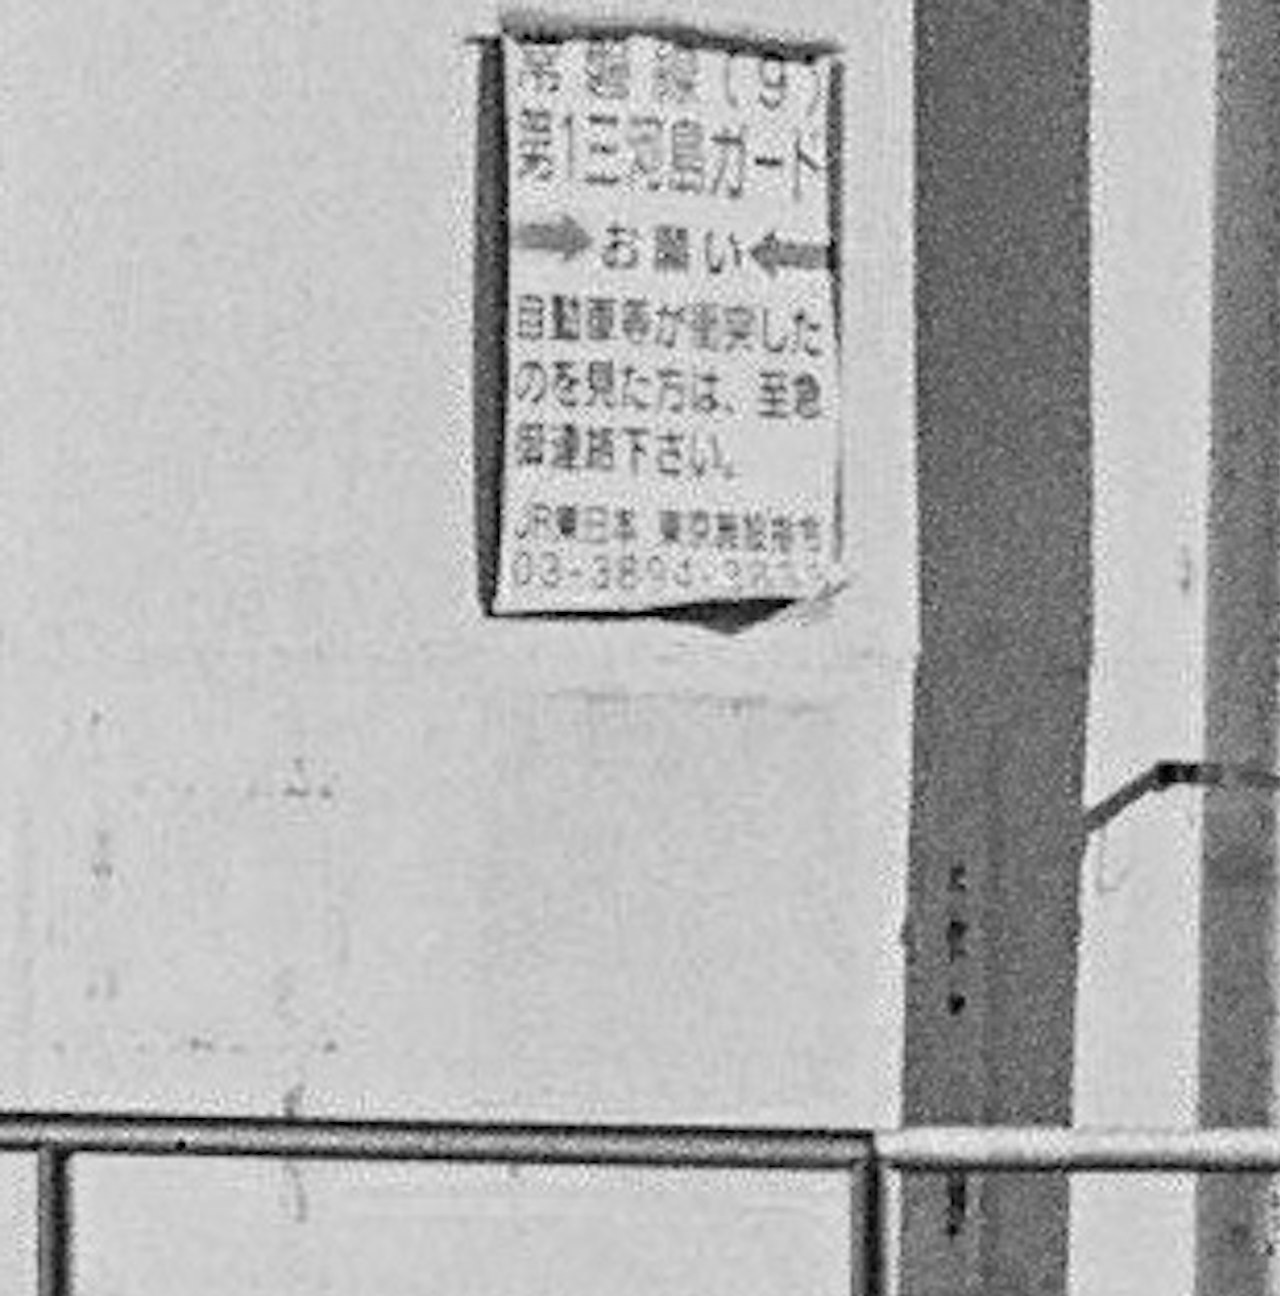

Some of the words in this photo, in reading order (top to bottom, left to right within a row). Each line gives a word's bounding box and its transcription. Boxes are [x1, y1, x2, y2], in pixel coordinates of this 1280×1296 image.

[601, 222, 743, 276] お願い
[517, 294, 822, 357] 自動車等が衝突した
